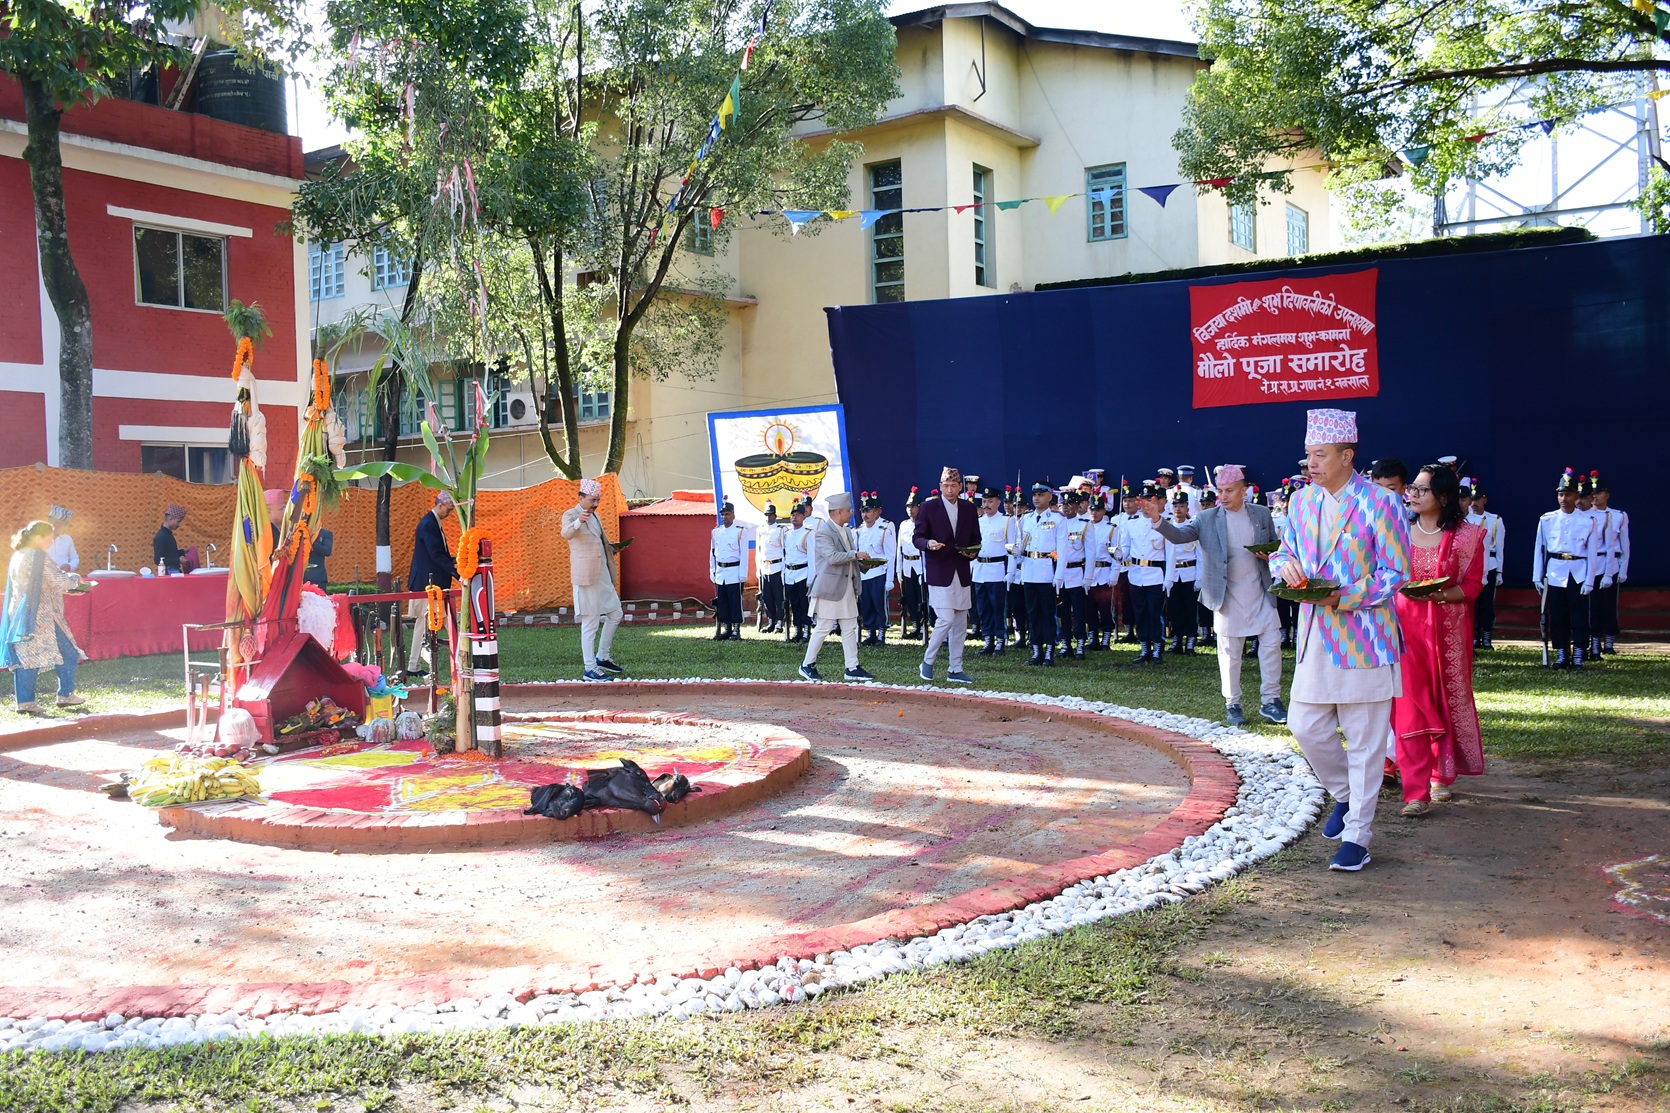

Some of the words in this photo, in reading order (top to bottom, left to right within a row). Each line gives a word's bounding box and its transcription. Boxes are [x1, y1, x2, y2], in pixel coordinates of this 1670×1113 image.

[1222, 296, 1254, 323] दशमी
[1262, 293, 1282, 315] शुभ
[1281, 285, 1336, 317] दिपावलीको
[1214, 332, 1249, 353] हार्दिक
[1251, 332, 1297, 347] मंगलमय
[1197, 352, 1237, 378] मौलो
[1239, 354, 1283, 380] पूजा
[1287, 343, 1368, 373] समारोह
